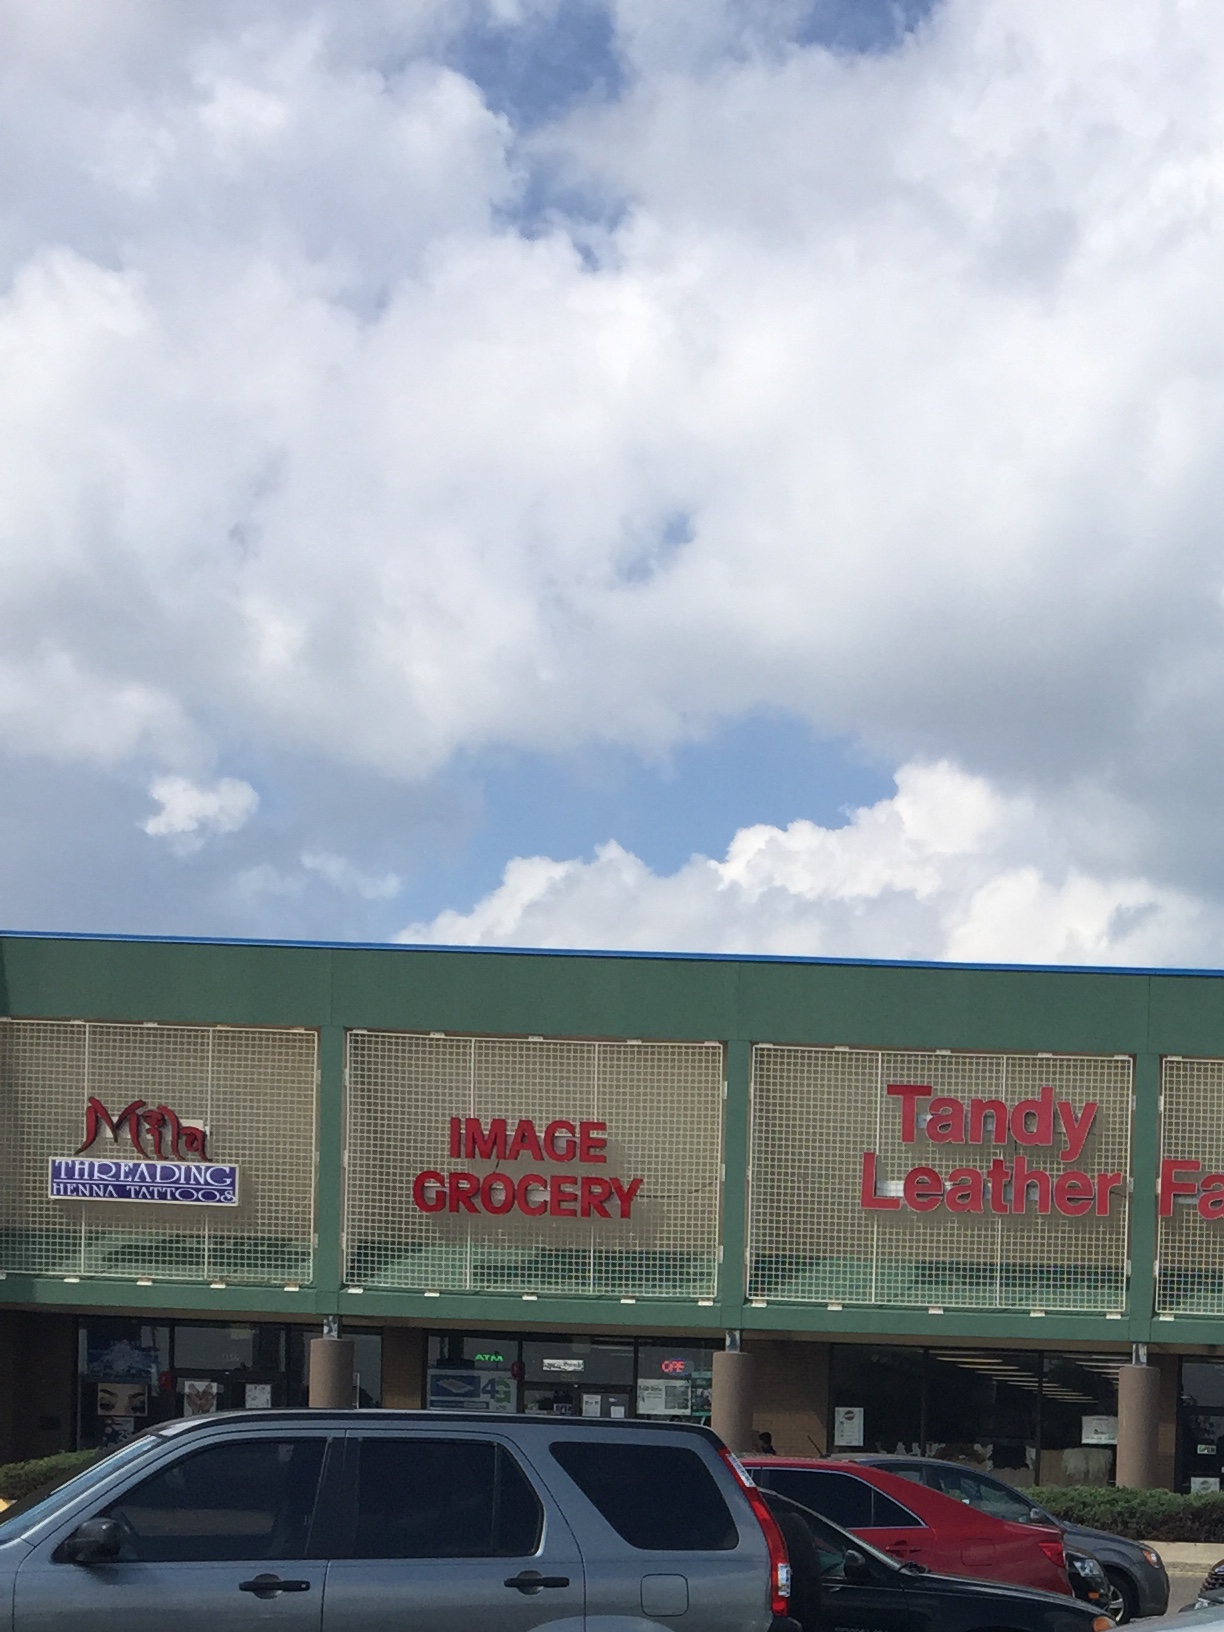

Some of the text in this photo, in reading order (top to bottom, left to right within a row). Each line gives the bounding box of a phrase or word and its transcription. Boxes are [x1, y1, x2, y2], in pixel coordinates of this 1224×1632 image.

[74, 1096, 213, 1162] Mila
[450, 1116, 607, 1163] IMAGE
[886, 1084, 1098, 1162] Tandy
[53, 1183, 236, 1203] HENNA TATTOOS
[54, 1160, 232, 1186] THREADING
[413, 1170, 644, 1219] GROCERY
[861, 1152, 1122, 1216] Leather
[475, 1353, 504, 1362] ATM
[661, 1360, 687, 1373] OPE
